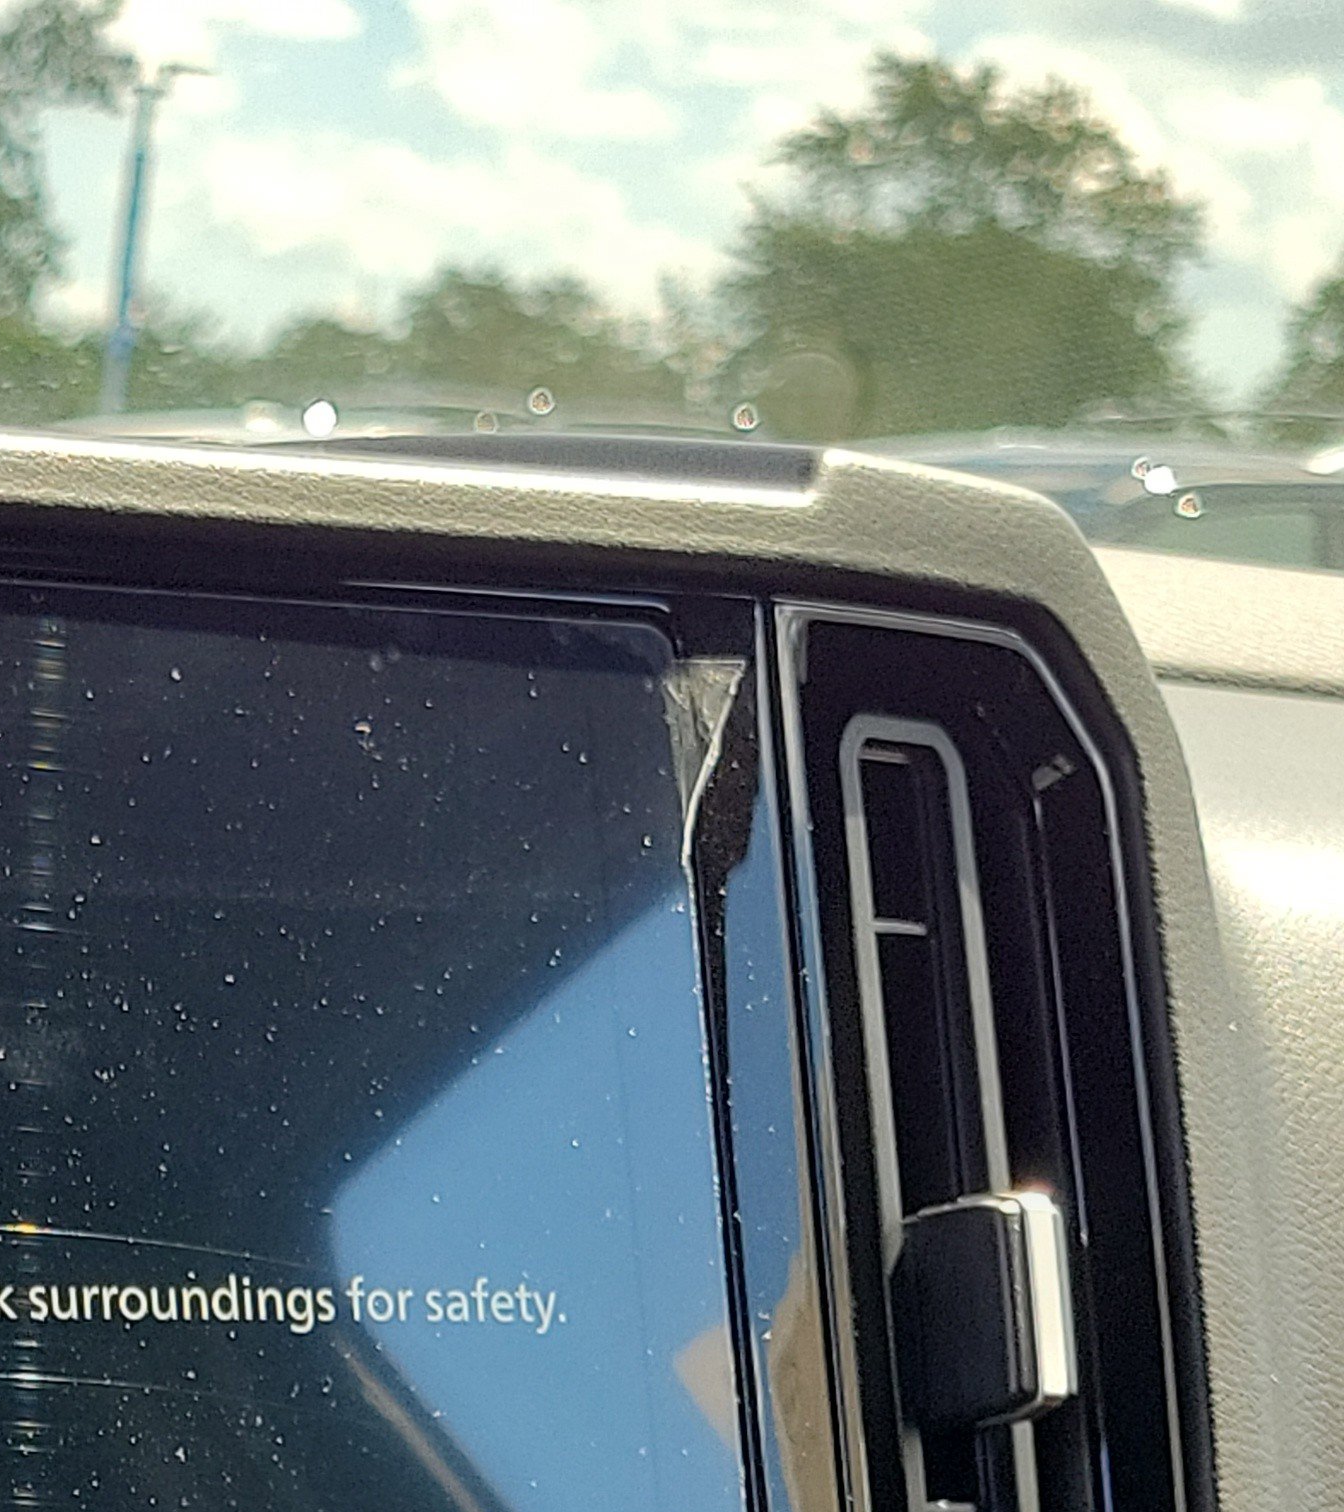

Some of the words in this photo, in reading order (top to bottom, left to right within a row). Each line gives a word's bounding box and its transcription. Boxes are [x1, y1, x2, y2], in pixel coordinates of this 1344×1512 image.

[27, 1273, 336, 1335] surroundings
[346, 1276, 411, 1325] for
[425, 1276, 568, 1334] safety.
